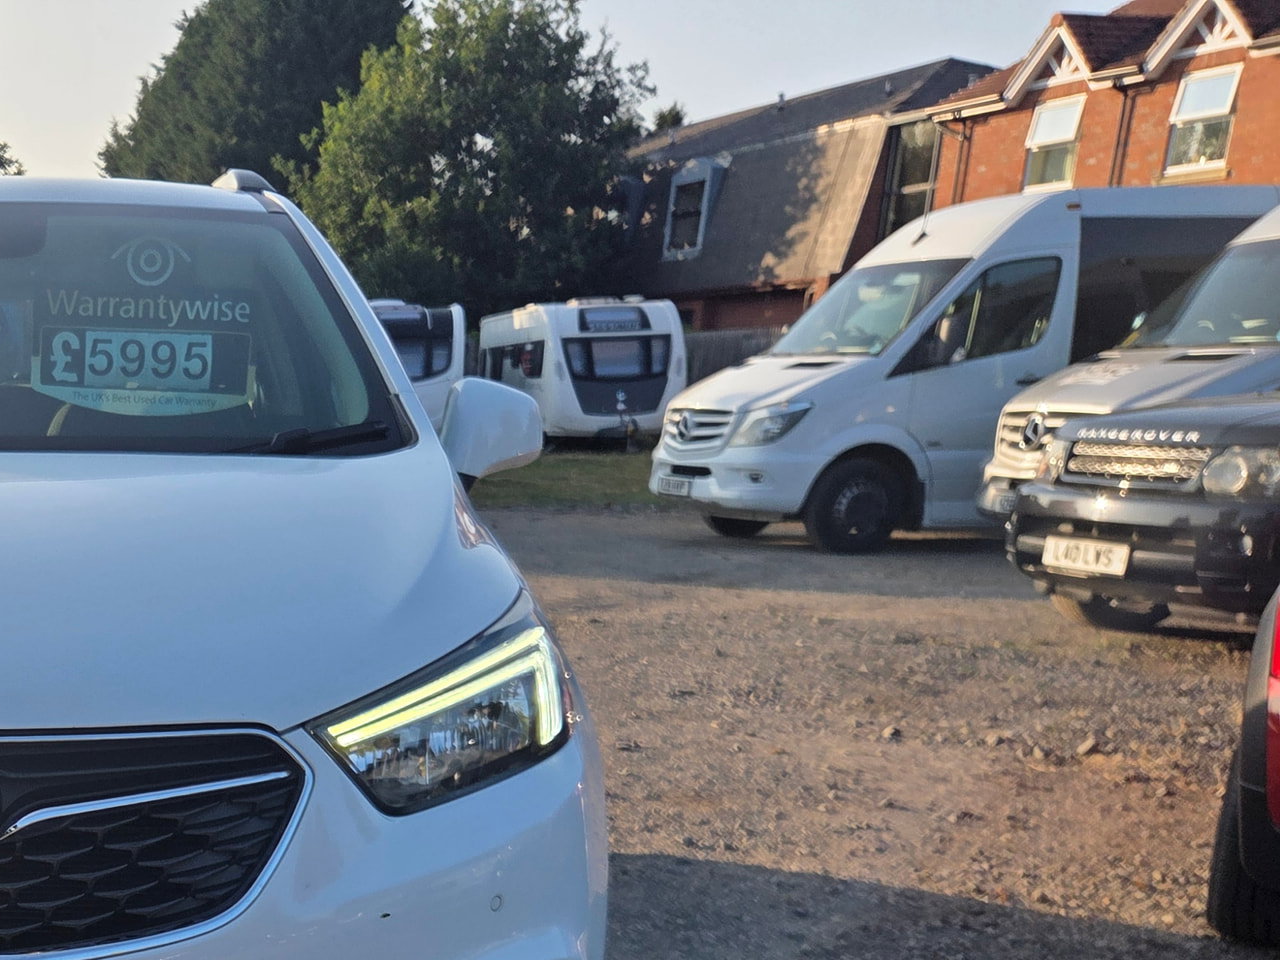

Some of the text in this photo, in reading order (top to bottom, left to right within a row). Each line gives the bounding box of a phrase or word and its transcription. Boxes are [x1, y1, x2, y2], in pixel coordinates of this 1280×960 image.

[46, 288, 251, 327] Warrantywise
[50, 330, 209, 382] £5995
[72, 391, 89, 401] The
[158, 395, 174, 405] Car
